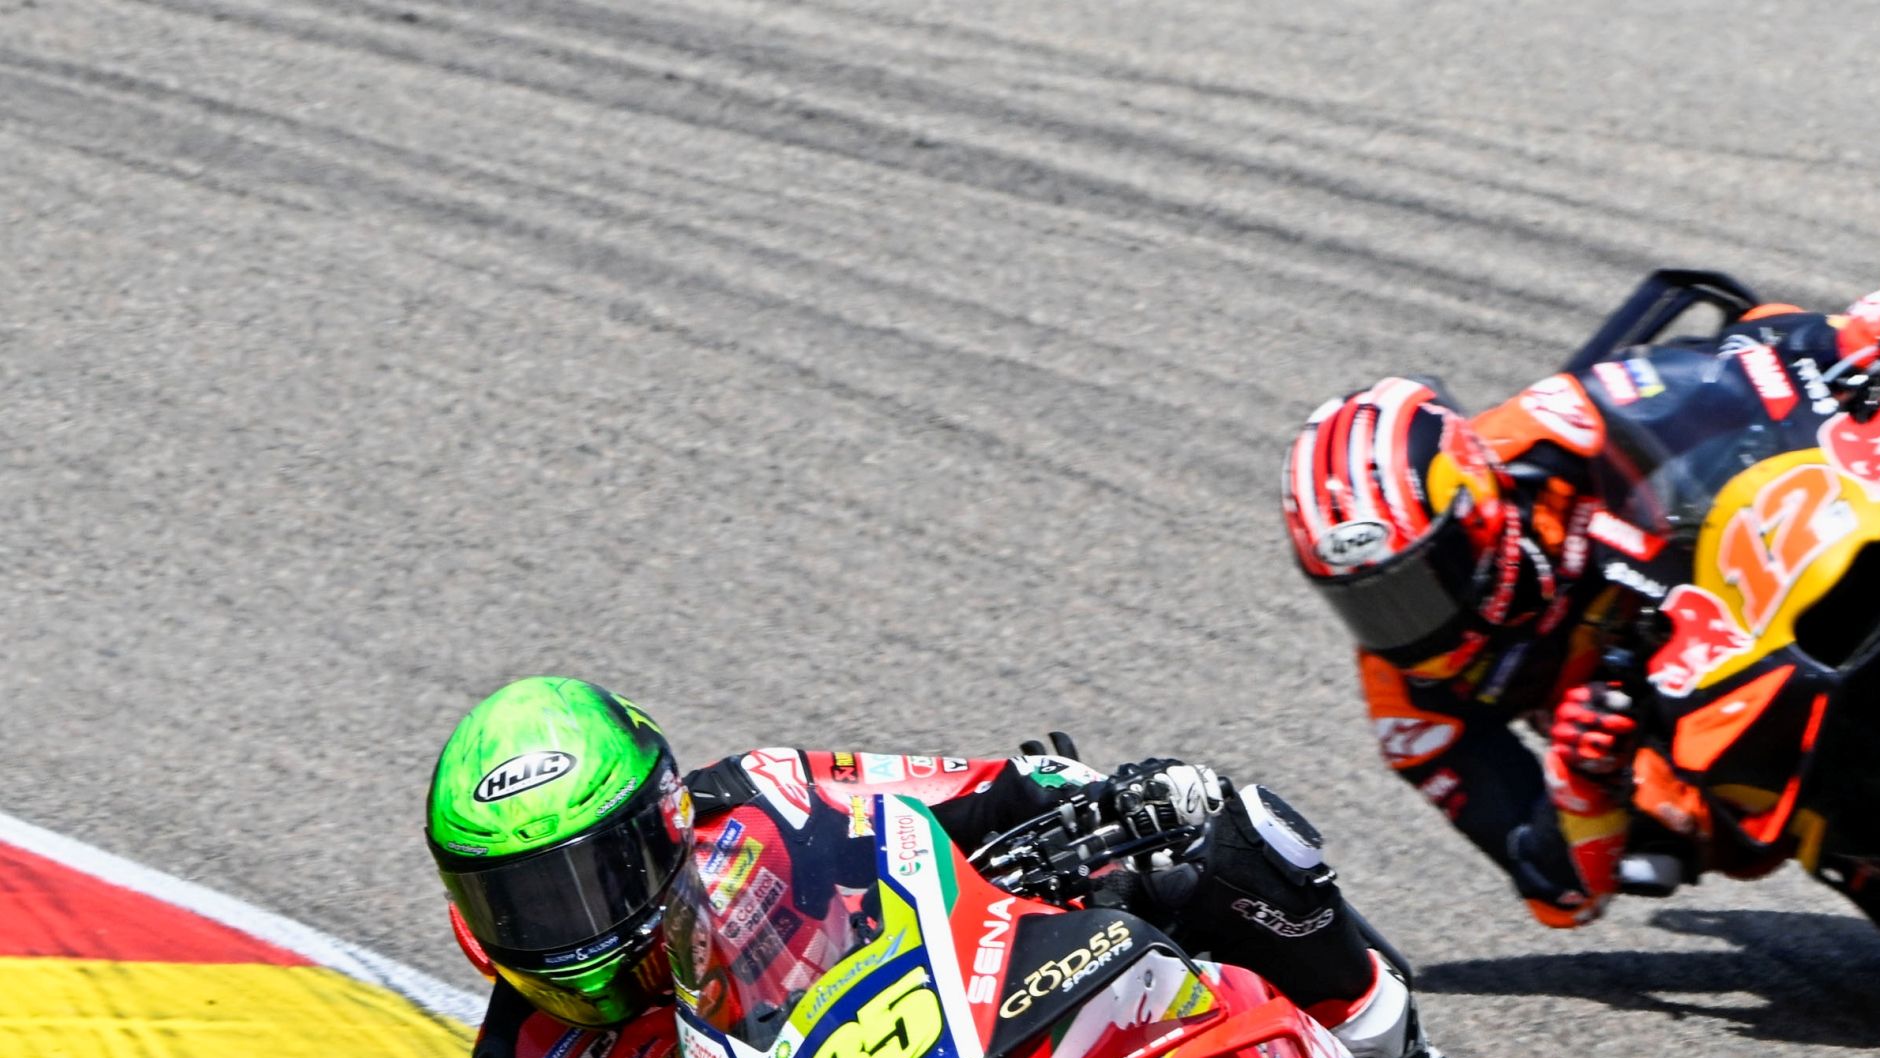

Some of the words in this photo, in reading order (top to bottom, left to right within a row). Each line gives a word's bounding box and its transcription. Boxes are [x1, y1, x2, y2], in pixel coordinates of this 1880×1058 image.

[1719, 464, 1841, 636] 12
[487, 755, 561, 797] HJC
[899, 815, 916, 861] Castrol
[967, 898, 1016, 1004] SENA
[1062, 938, 1133, 992] SPORTS
